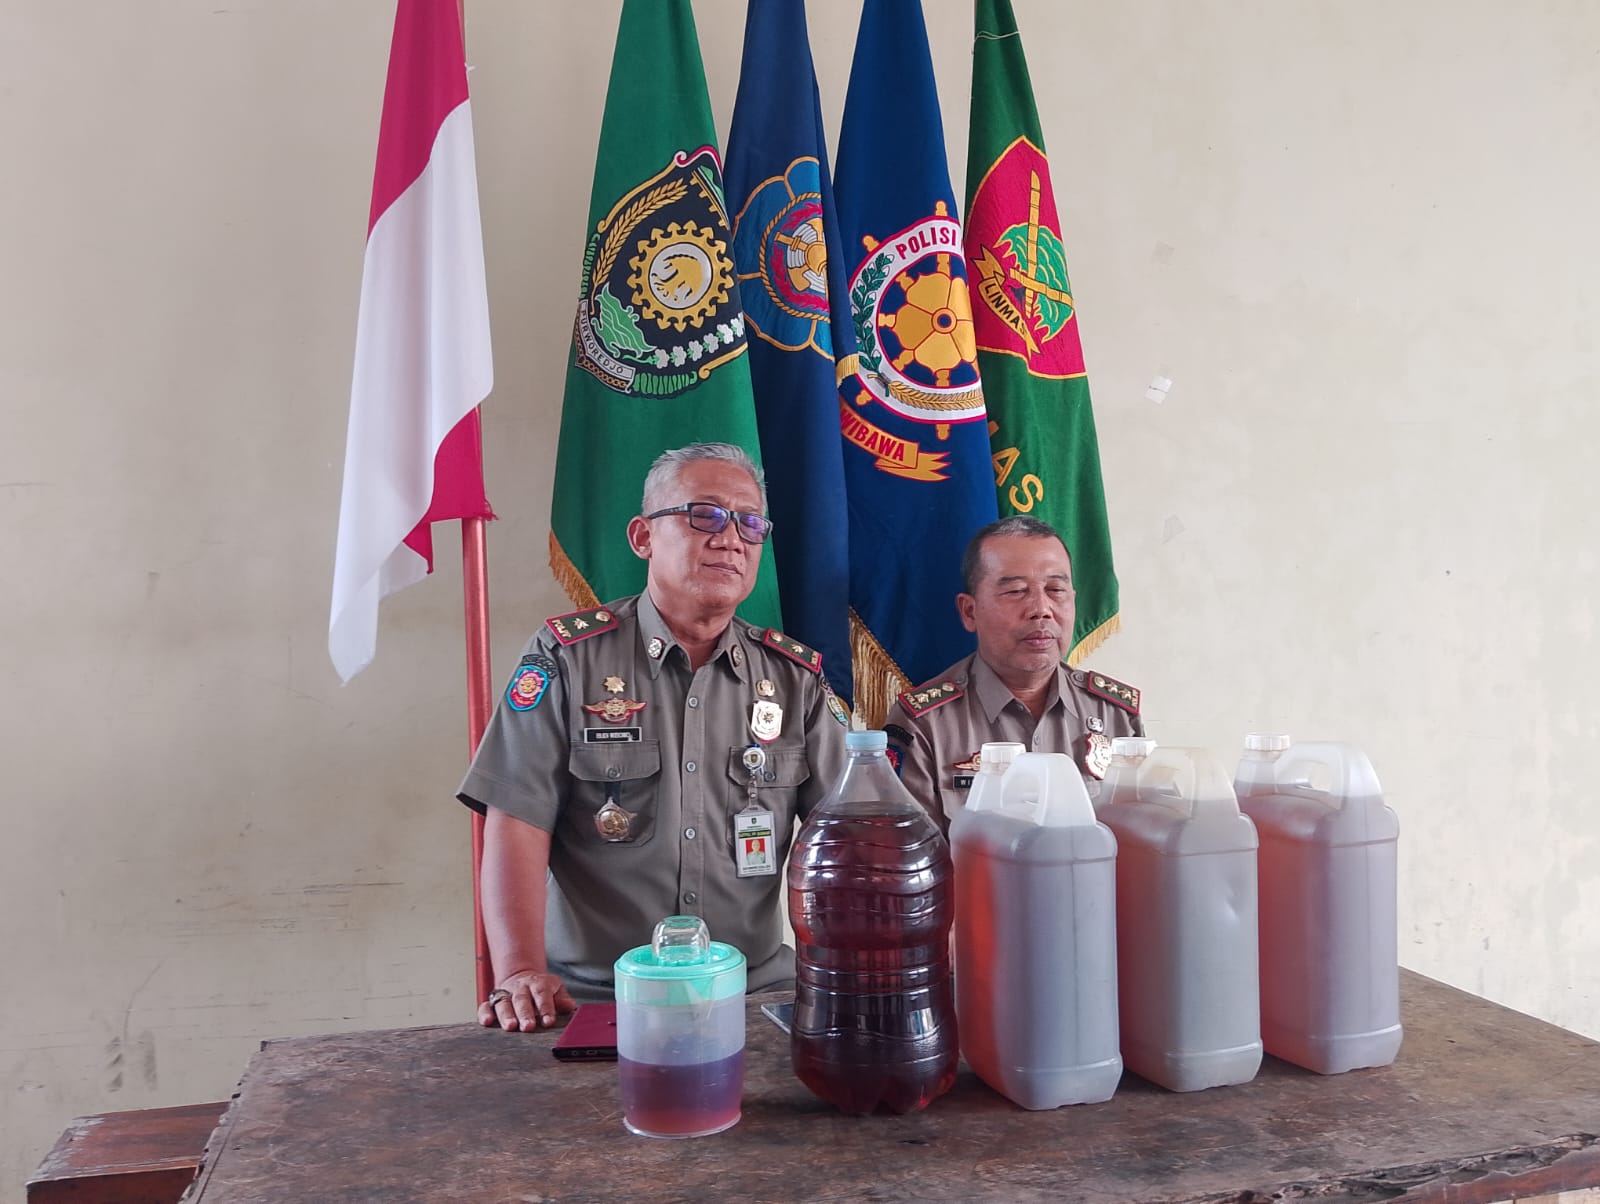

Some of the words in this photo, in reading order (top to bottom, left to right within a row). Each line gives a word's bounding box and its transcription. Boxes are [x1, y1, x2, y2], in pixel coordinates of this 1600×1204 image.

[895, 226, 958, 260] POLISI
[984, 283, 1028, 335] LINMAS
[580, 310, 624, 375] PURWOREDJO
[987, 420, 1043, 513] AS
